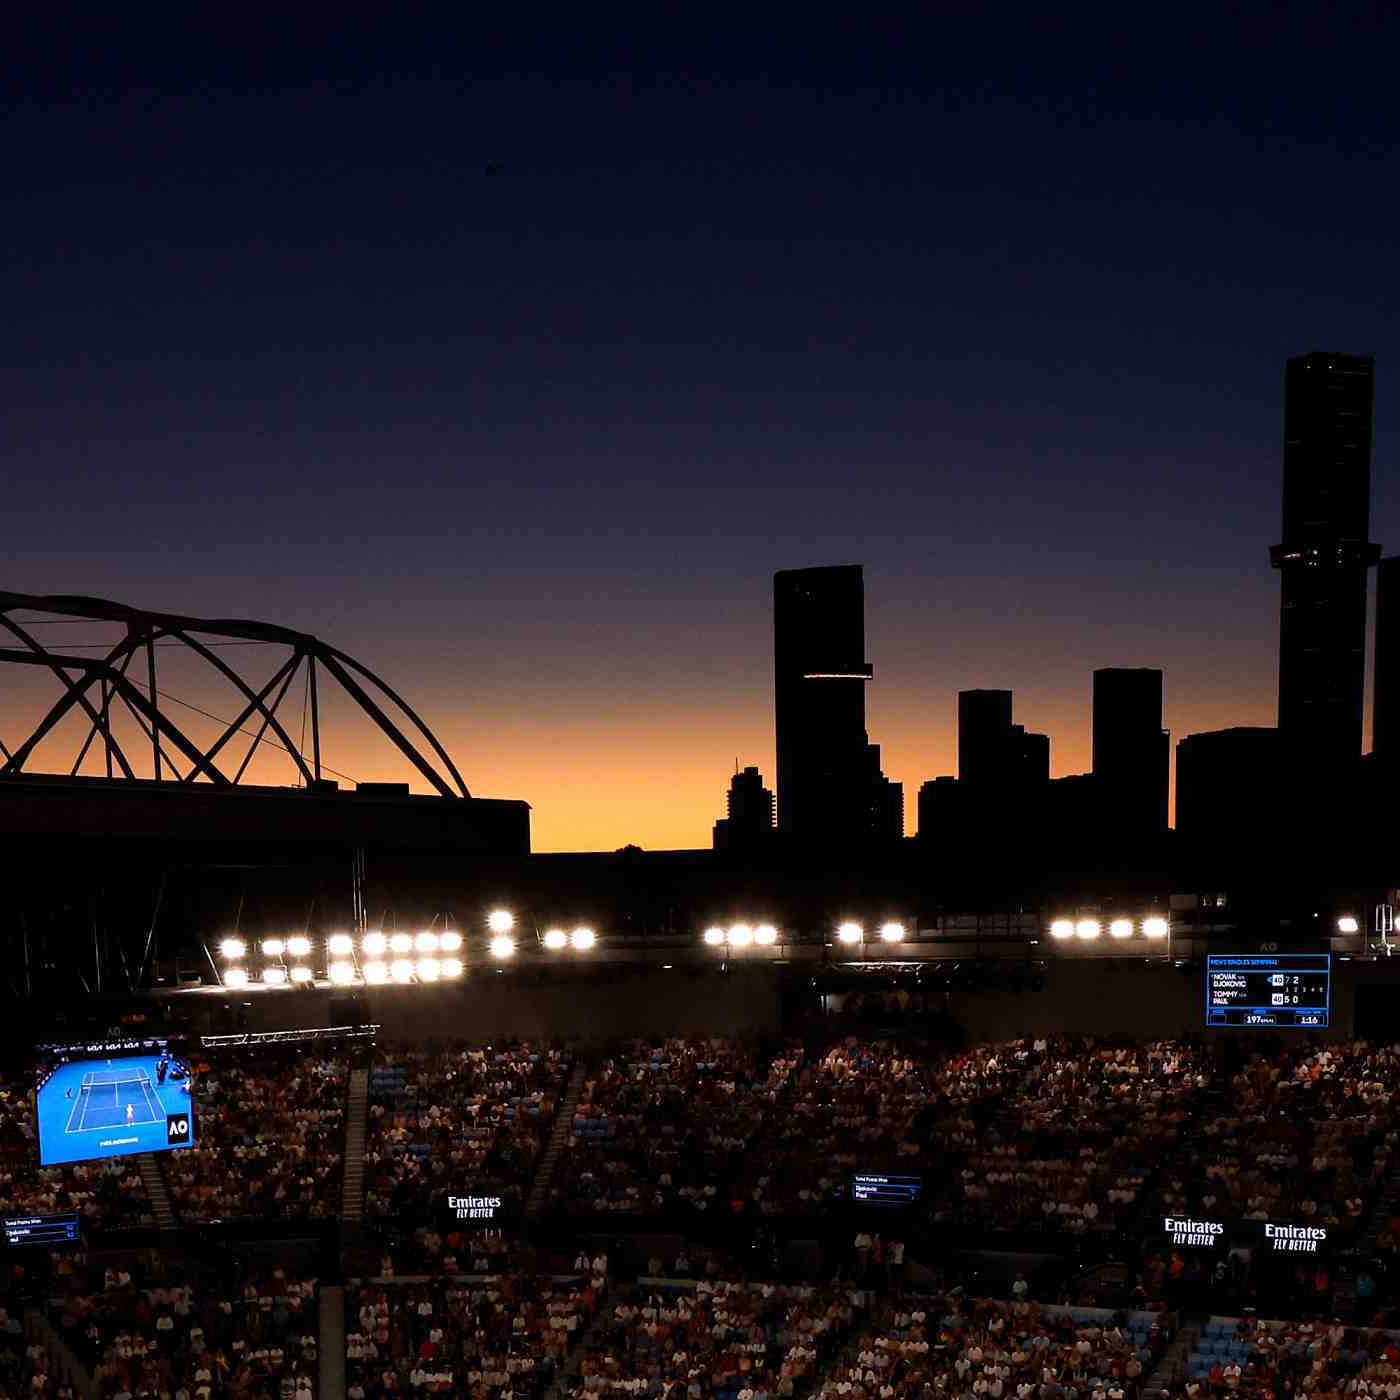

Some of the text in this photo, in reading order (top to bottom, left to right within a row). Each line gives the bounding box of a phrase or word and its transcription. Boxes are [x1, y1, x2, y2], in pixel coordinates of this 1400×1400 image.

[169, 1121, 188, 1136] AO
[448, 1196, 501, 1208] Emirates
[457, 1209, 468, 1218] FLY
[1165, 1218, 1223, 1235] Emirates
[1265, 1224, 1326, 1240] Emirates
[1173, 1233, 1214, 1246] FLY BETTER
[1273, 1239, 1317, 1251] FLY BETTER
